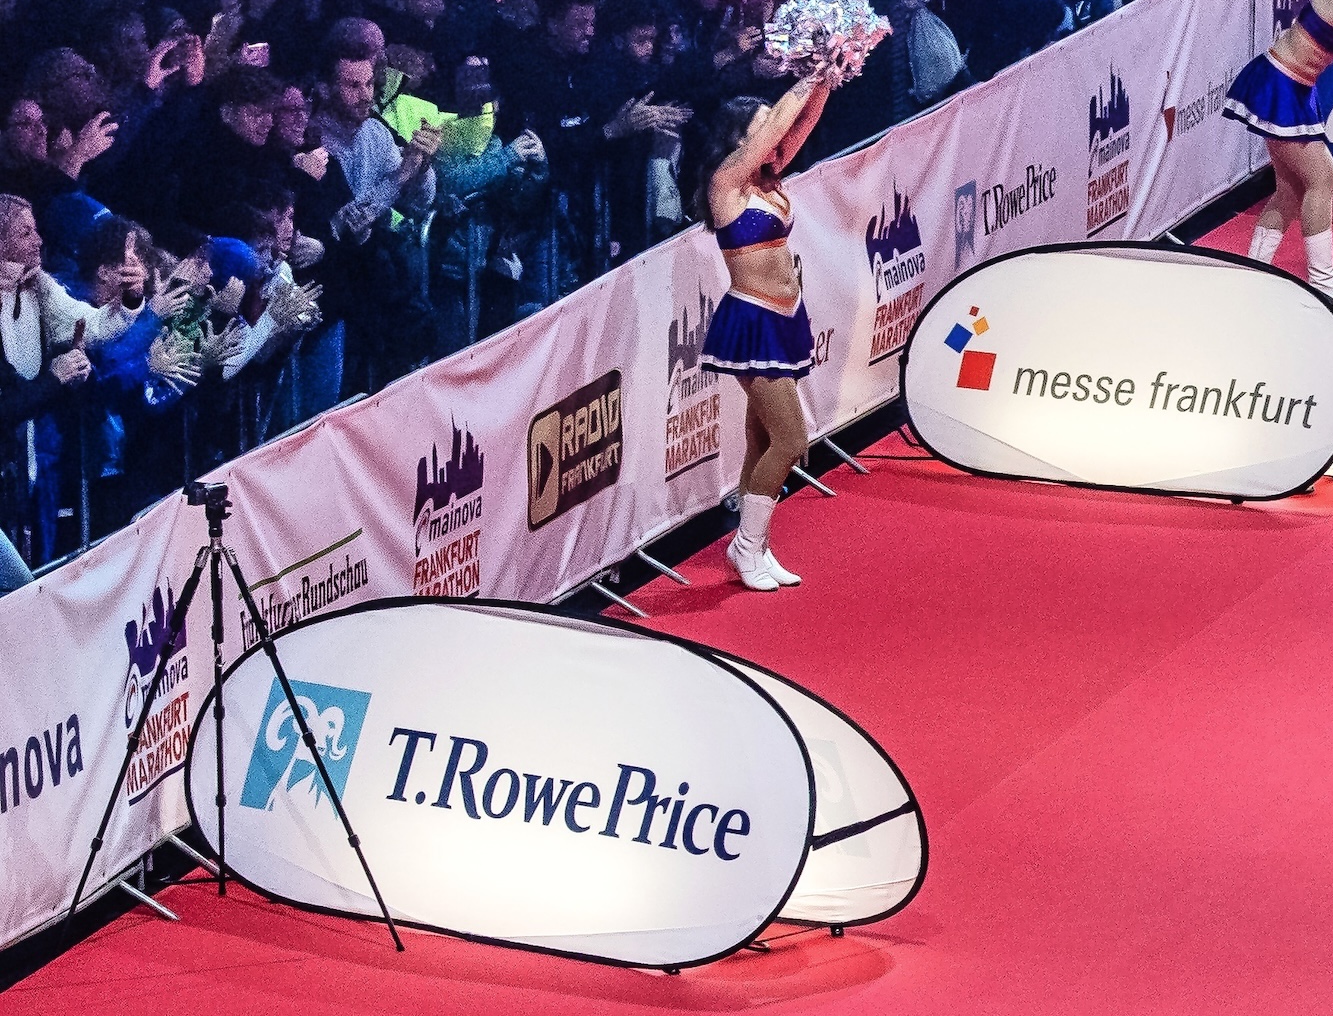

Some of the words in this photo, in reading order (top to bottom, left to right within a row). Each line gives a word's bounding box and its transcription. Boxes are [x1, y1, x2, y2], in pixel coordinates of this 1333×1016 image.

[883, 251, 926, 291] mainova
[874, 282, 926, 331] FRANKFURT
[666, 393, 720, 444] FRANKFUR
[1012, 365, 1135, 407] messe
[1148, 371, 1317, 429] frankfurt
[561, 388, 622, 461] RADIO
[665, 423, 720, 473] MARATHO
[428, 495, 482, 542] mainova
[413, 529, 481, 583] FRANKFURT
[302, 554, 369, 618] Rundschau
[131, 691, 189, 758] ANKFURT
